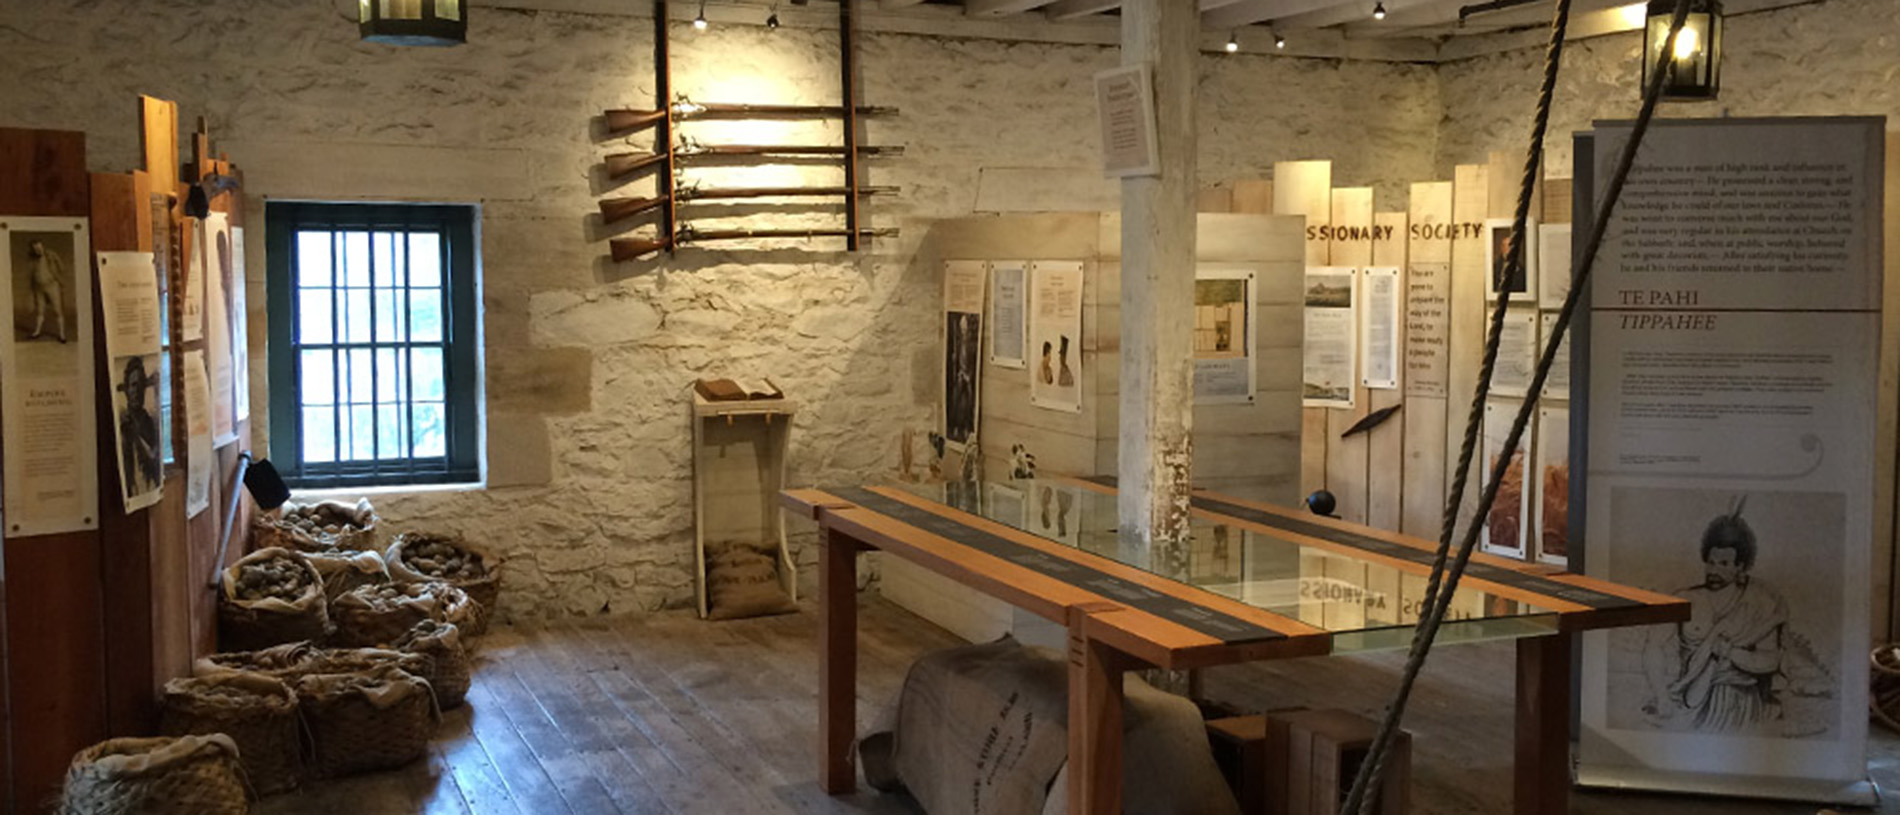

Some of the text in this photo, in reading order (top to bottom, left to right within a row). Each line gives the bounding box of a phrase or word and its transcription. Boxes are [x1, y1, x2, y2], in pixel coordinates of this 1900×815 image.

[1410, 222, 1483, 240] SOCIETY
[1618, 289, 1699, 306] TE PAHI
[1619, 313, 1718, 331] TIPPAHEE
